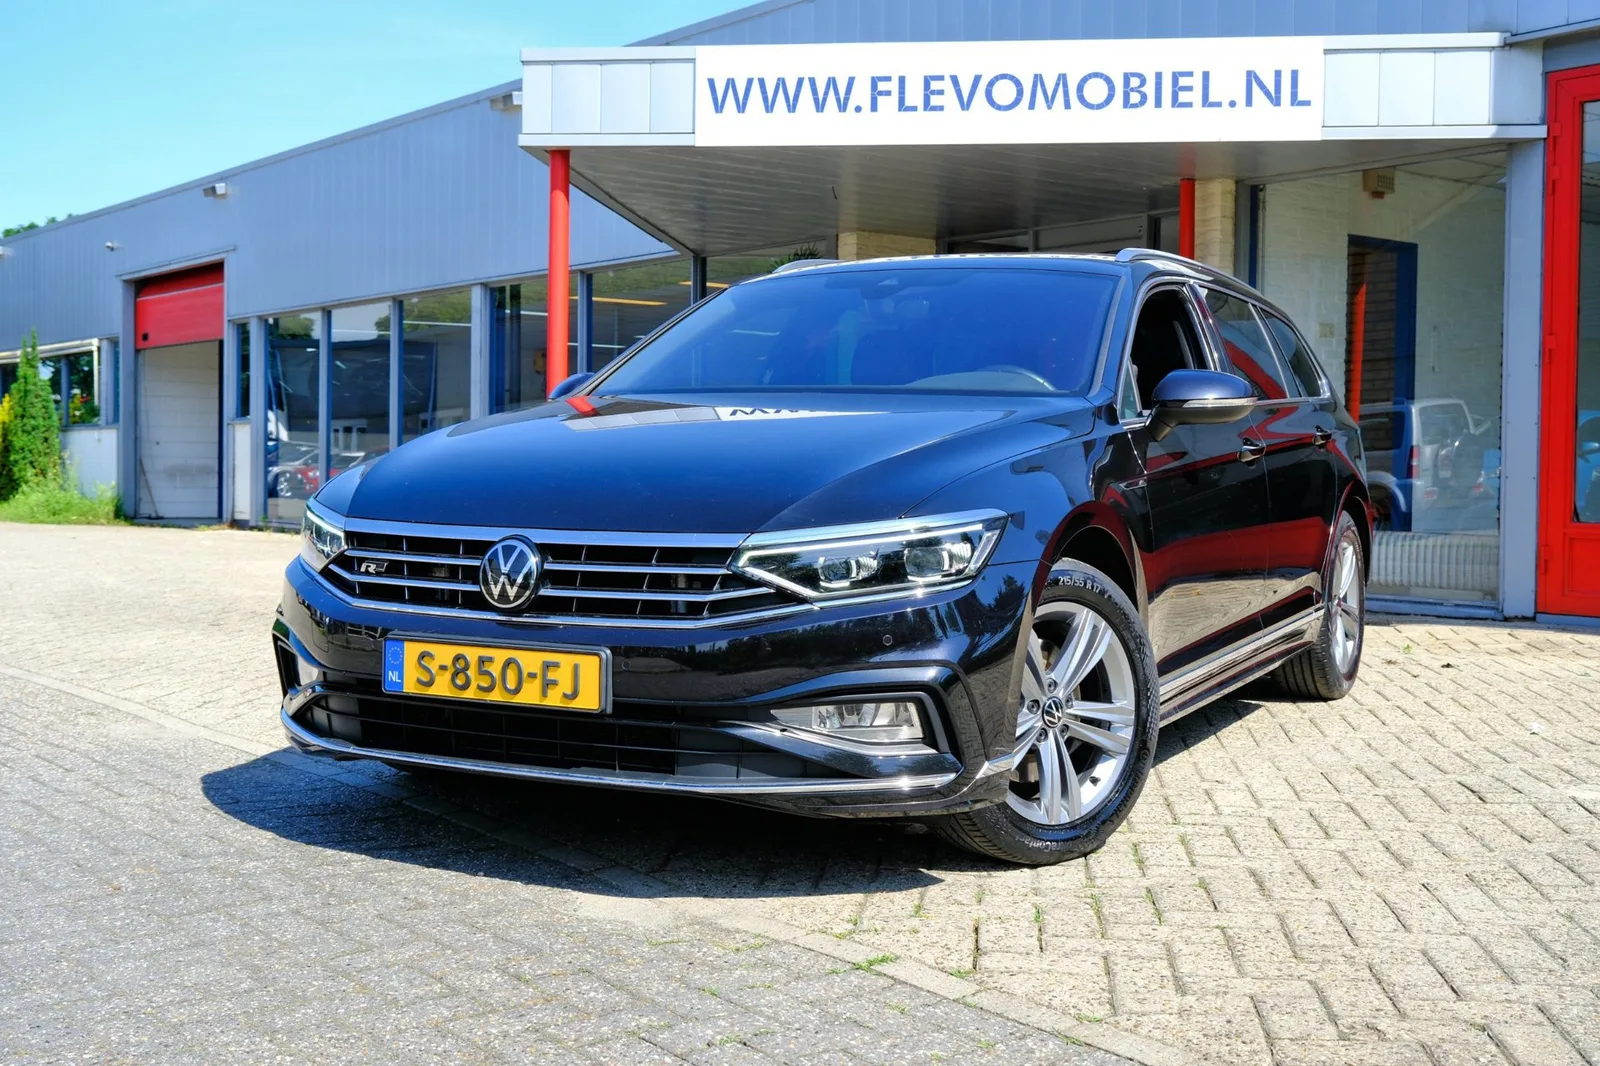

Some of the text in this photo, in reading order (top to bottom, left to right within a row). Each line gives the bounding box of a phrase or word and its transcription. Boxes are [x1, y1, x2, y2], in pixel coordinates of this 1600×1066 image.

[706, 69, 1312, 114] WWW.FLEVOMOBIEL.NL
[1058, 575, 1085, 587] 215/55
[1086, 580, 1092, 590] R
[1093, 582, 1101, 593] 17
[388, 670, 401, 682] NL
[416, 650, 580, 700] S-850-FJ
